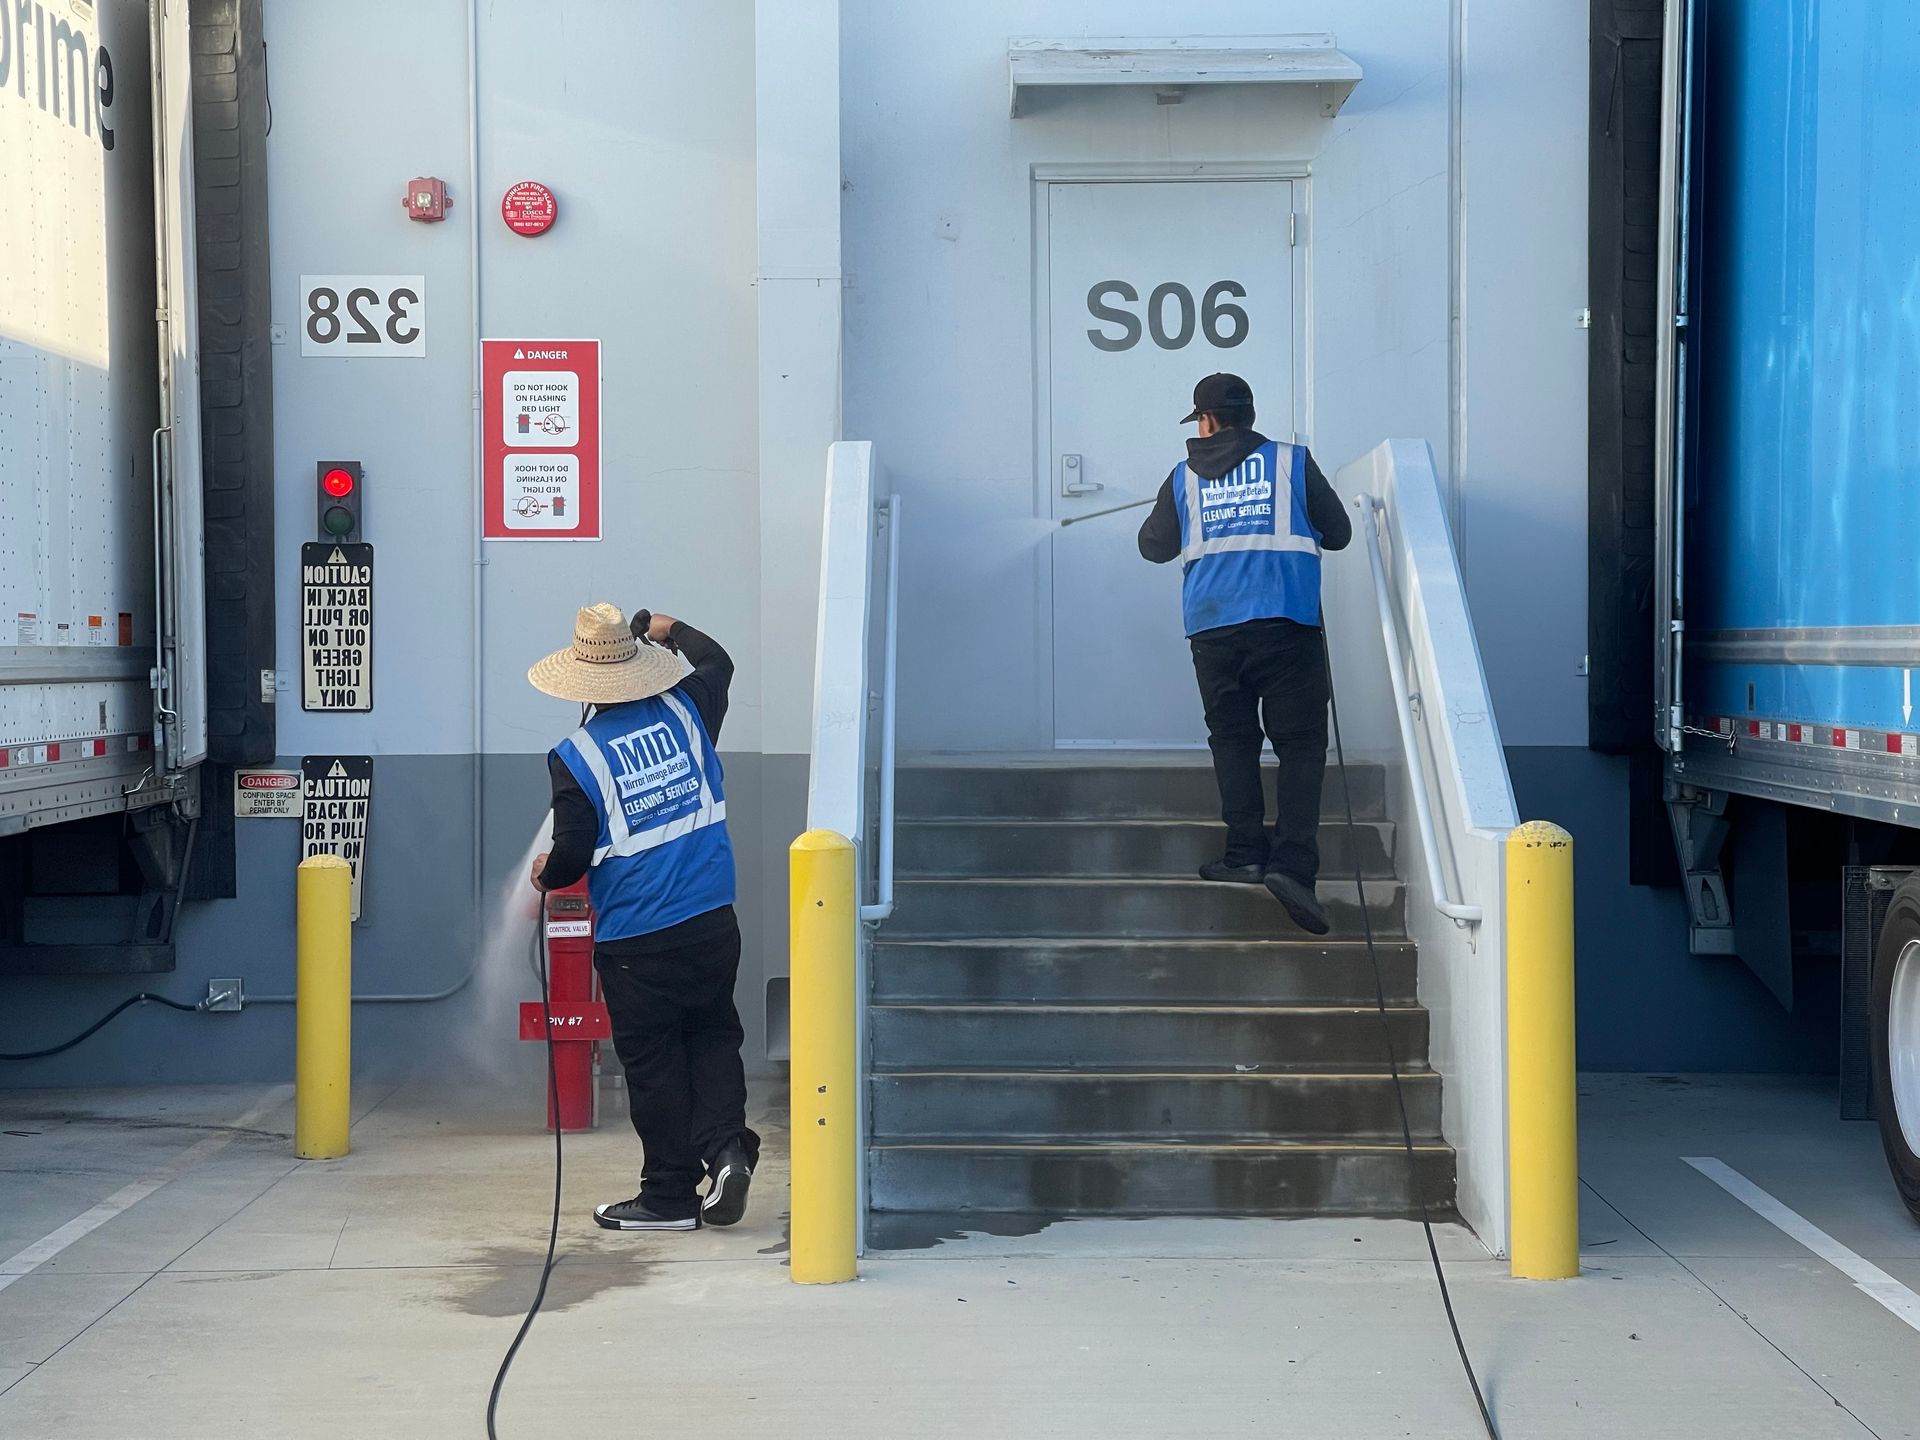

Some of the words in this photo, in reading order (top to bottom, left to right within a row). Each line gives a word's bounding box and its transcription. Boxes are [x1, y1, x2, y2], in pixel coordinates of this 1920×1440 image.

[0, 0, 114, 151] rime
[506, 183, 529, 209] SPRINKLER
[530, 183, 544, 193] FIRE
[543, 193, 552, 214] ALARM
[1087, 280, 1249, 352] S06
[527, 351, 568, 359] DANGER
[1206, 492, 1226, 501] Mirror
[1226, 488, 1246, 499] Image
[1247, 485, 1269, 496] Details
[1203, 507, 1236, 522] CLEANING
[1238, 504, 1271, 517] SERVICES
[616, 726, 678, 775] MID
[247, 777, 292, 786] DANGER
[623, 776, 645, 790] Mirror
[645, 769, 667, 783] Image
[667, 758, 689, 774] Details
[304, 779, 370, 797] CAUTION
[625, 791, 664, 815] CLEANING
[665, 777, 699, 800] SERVICES
[307, 802, 348, 819] BACK
[352, 802, 366, 819] IN
[305, 823, 325, 839] OR
[331, 822, 364, 839] PULL
[308, 843, 338, 858] OUT
[344, 842, 360, 859] ON
[568, 1017, 583, 1025] #7
